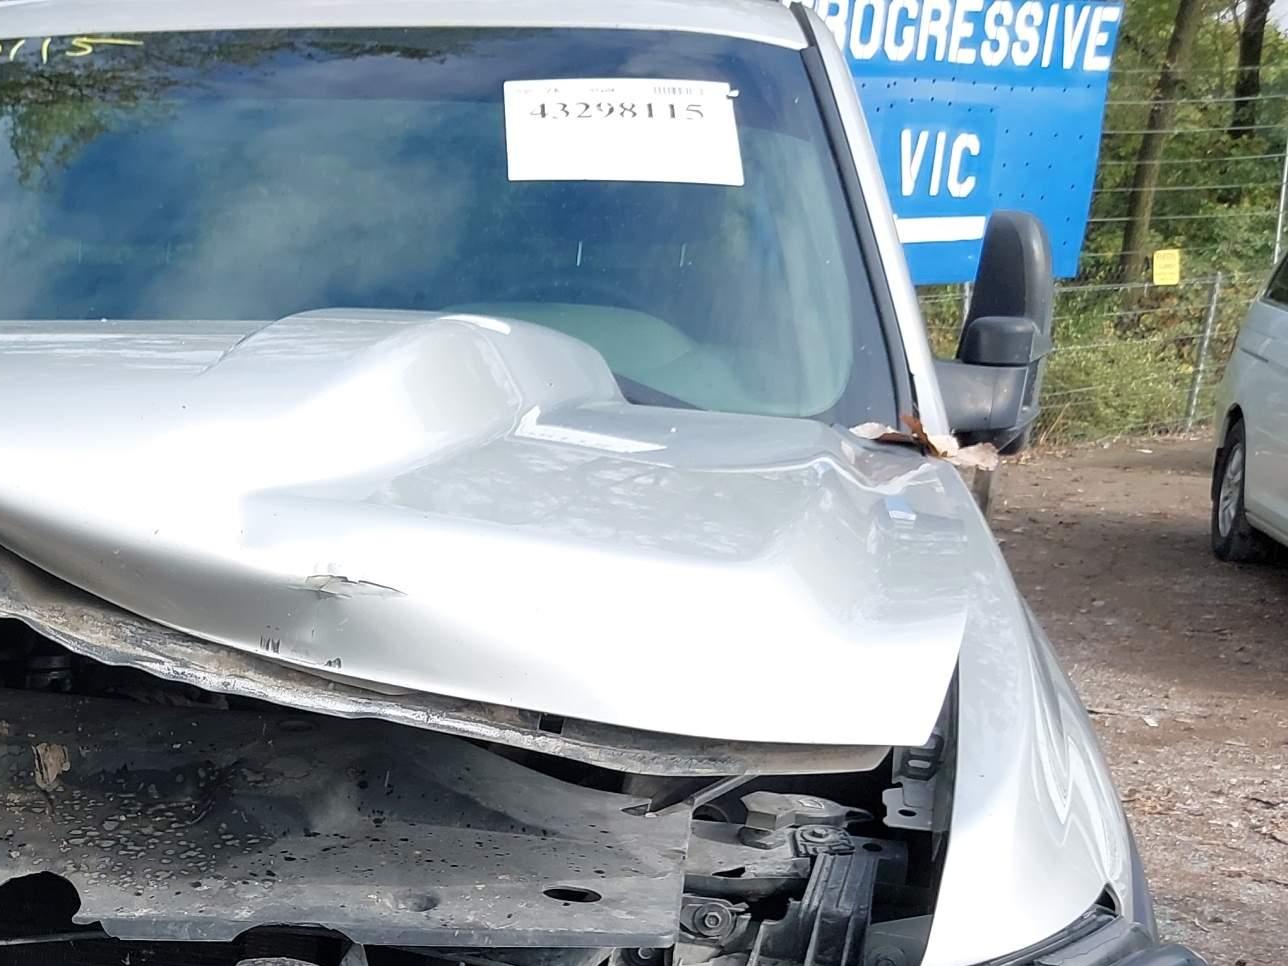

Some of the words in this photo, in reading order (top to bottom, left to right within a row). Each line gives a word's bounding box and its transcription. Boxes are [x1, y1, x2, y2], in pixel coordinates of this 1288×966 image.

[784, 0, 1121, 72] ROGRESSIVE
[529, 102, 705, 121] 43298115
[899, 128, 981, 199] VIC
